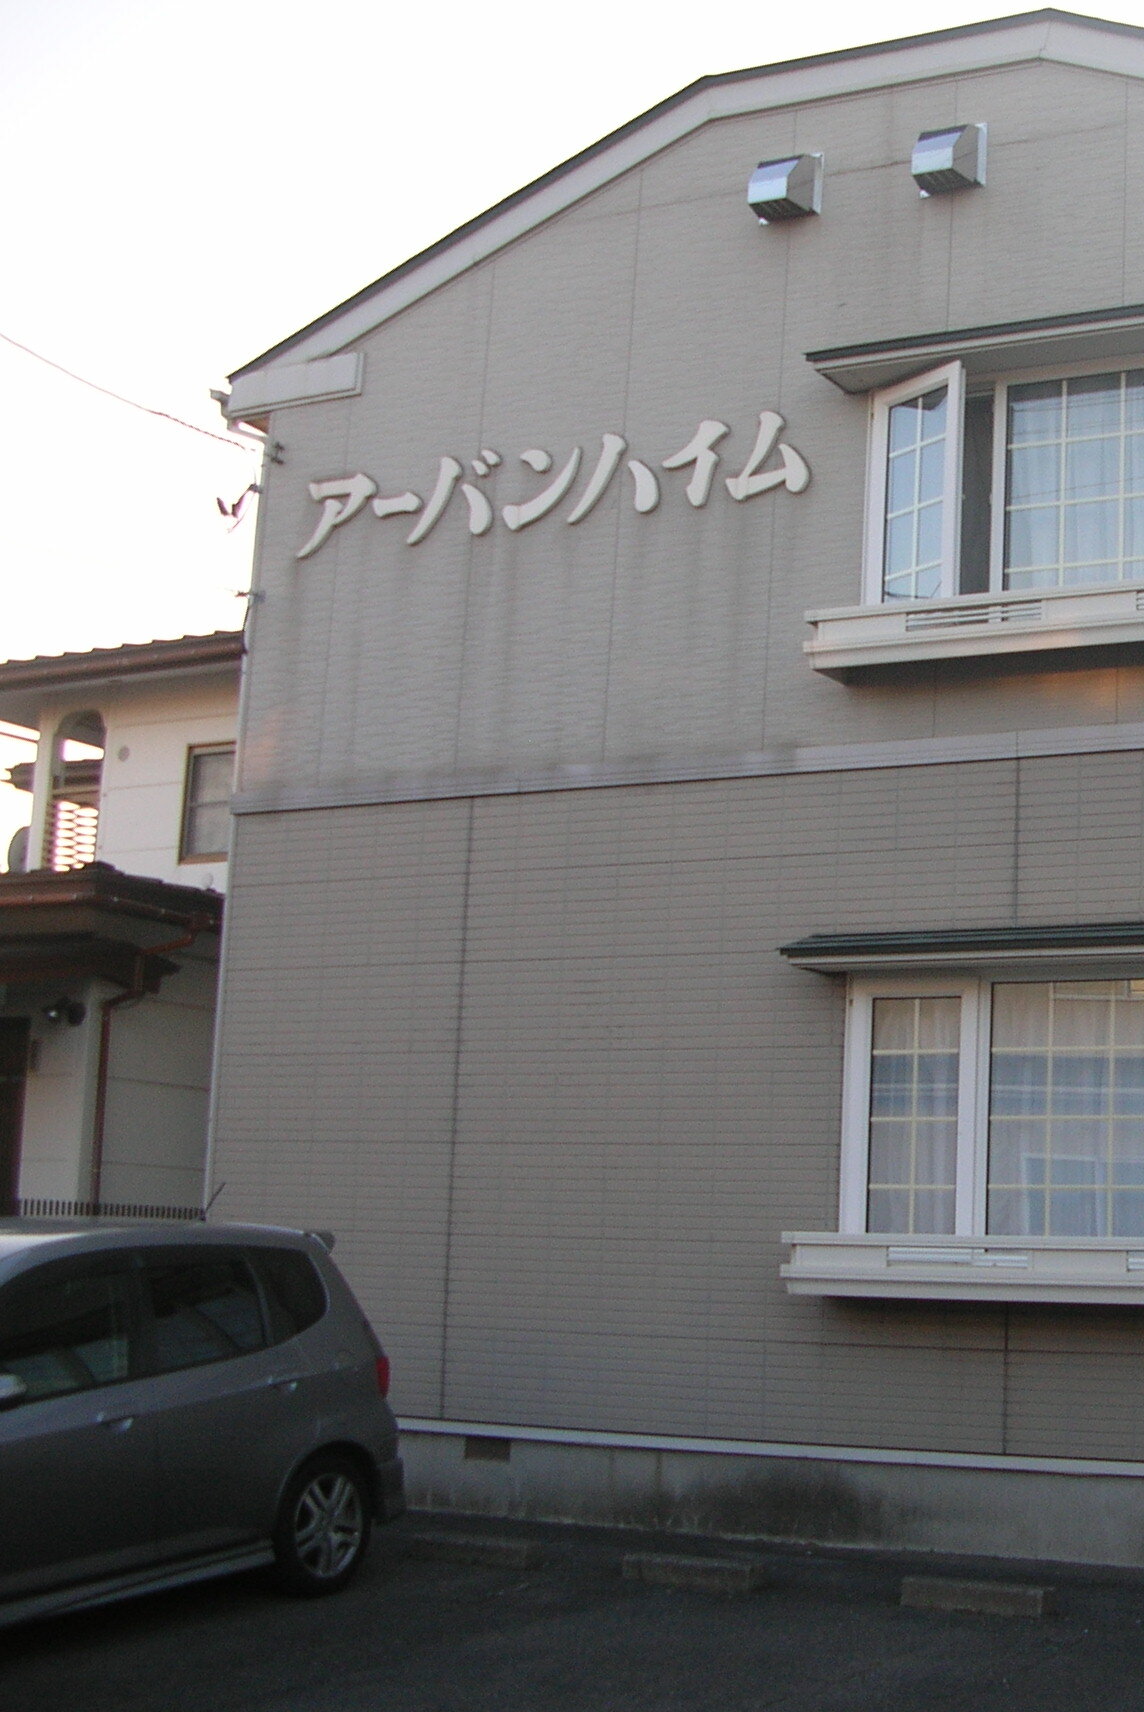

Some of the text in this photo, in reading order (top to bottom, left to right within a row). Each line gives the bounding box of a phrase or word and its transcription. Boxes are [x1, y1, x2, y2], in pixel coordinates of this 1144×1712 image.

[298, 410, 810, 558] アーバンハイム
